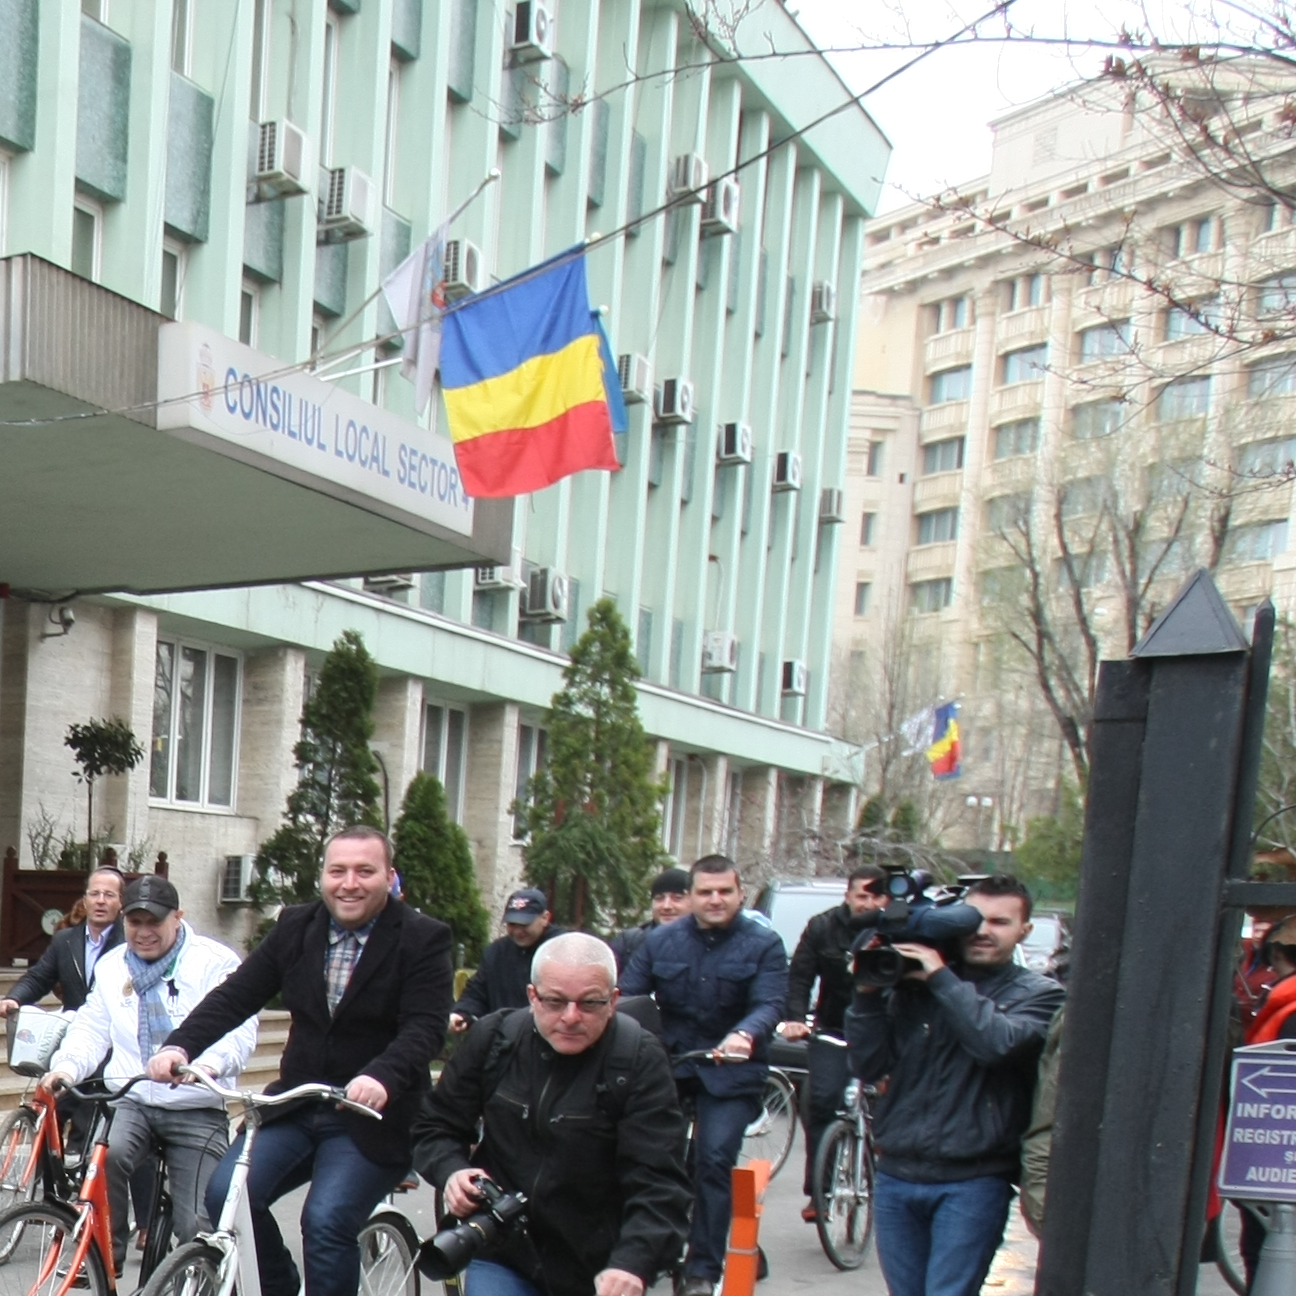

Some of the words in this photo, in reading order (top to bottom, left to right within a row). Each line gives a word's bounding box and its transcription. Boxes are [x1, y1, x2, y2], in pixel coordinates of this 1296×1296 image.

[224, 366, 327, 452] CONSILIUL
[334, 413, 390, 478] LOCAL
[397, 442, 459, 508] SECTOR
